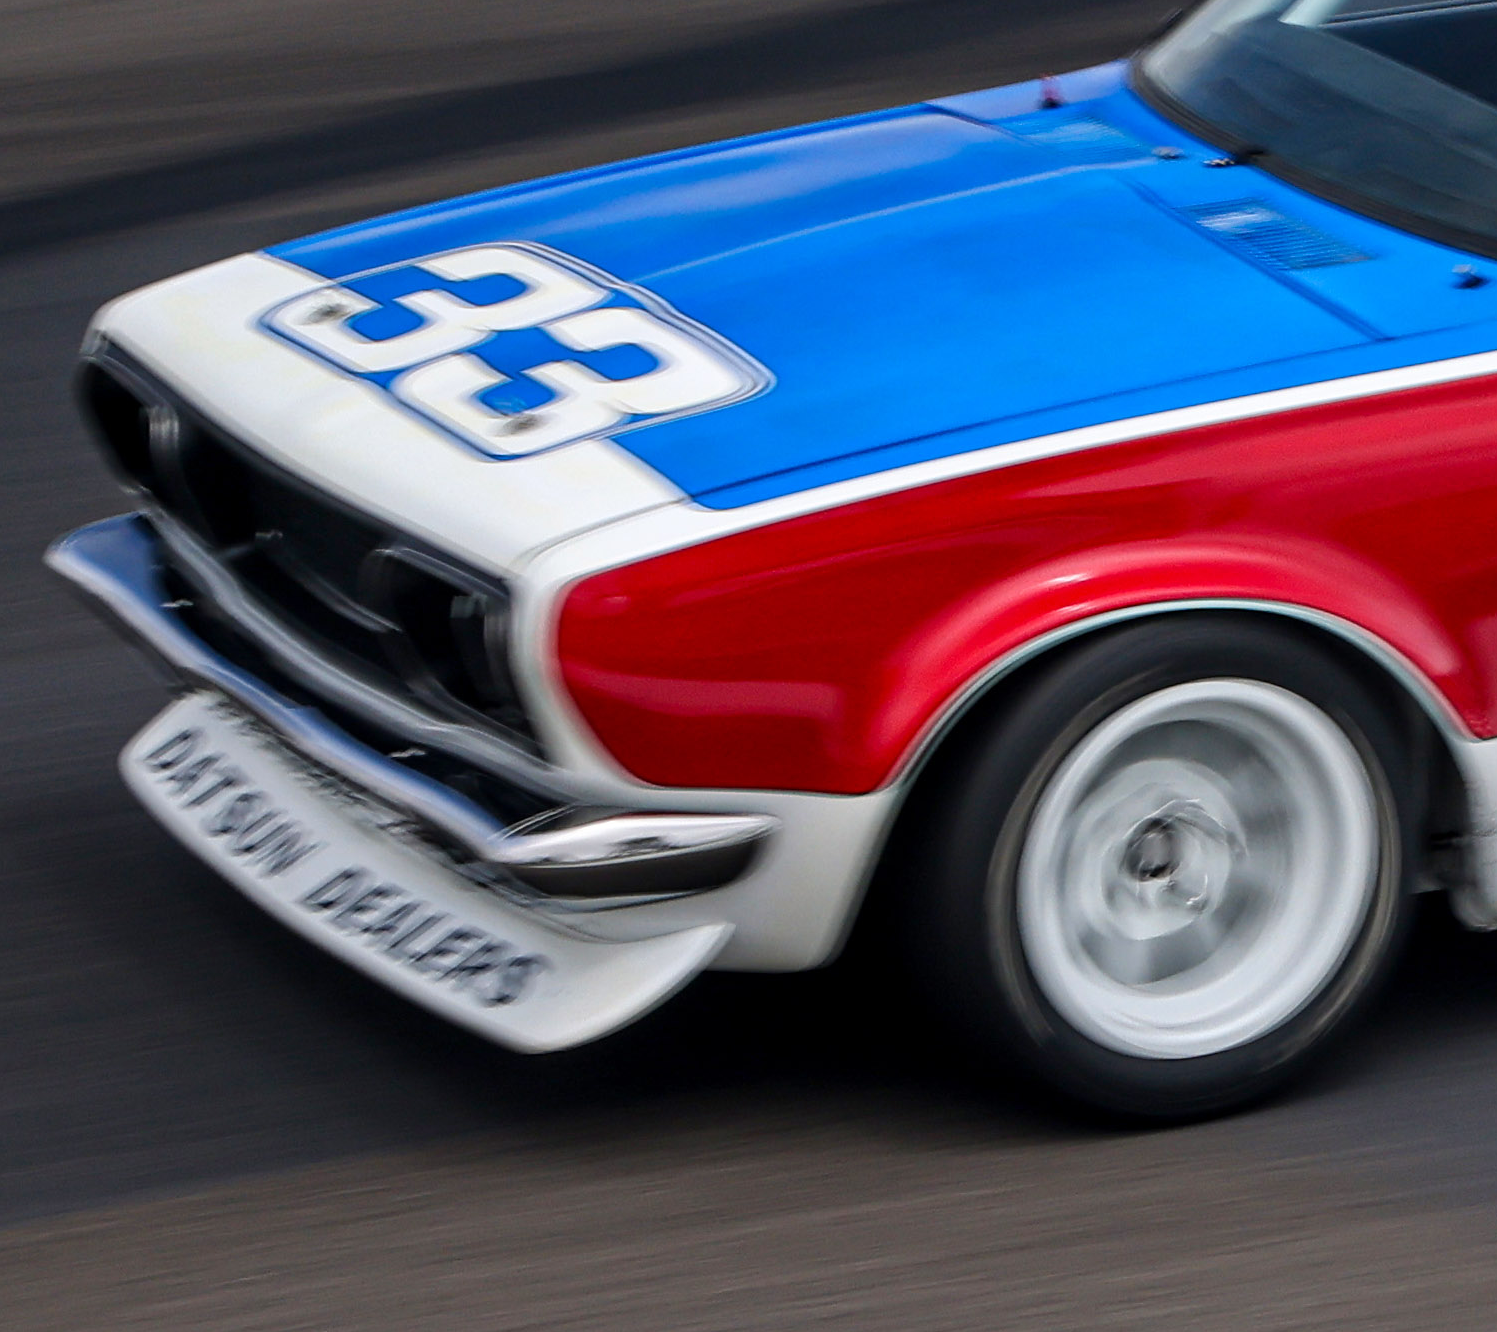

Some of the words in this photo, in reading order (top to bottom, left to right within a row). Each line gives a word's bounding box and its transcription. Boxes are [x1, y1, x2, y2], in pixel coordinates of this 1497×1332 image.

[271, 246, 755, 456] 33
[141, 727, 325, 878] DATSUN
[295, 865, 553, 1008] DEALERS
